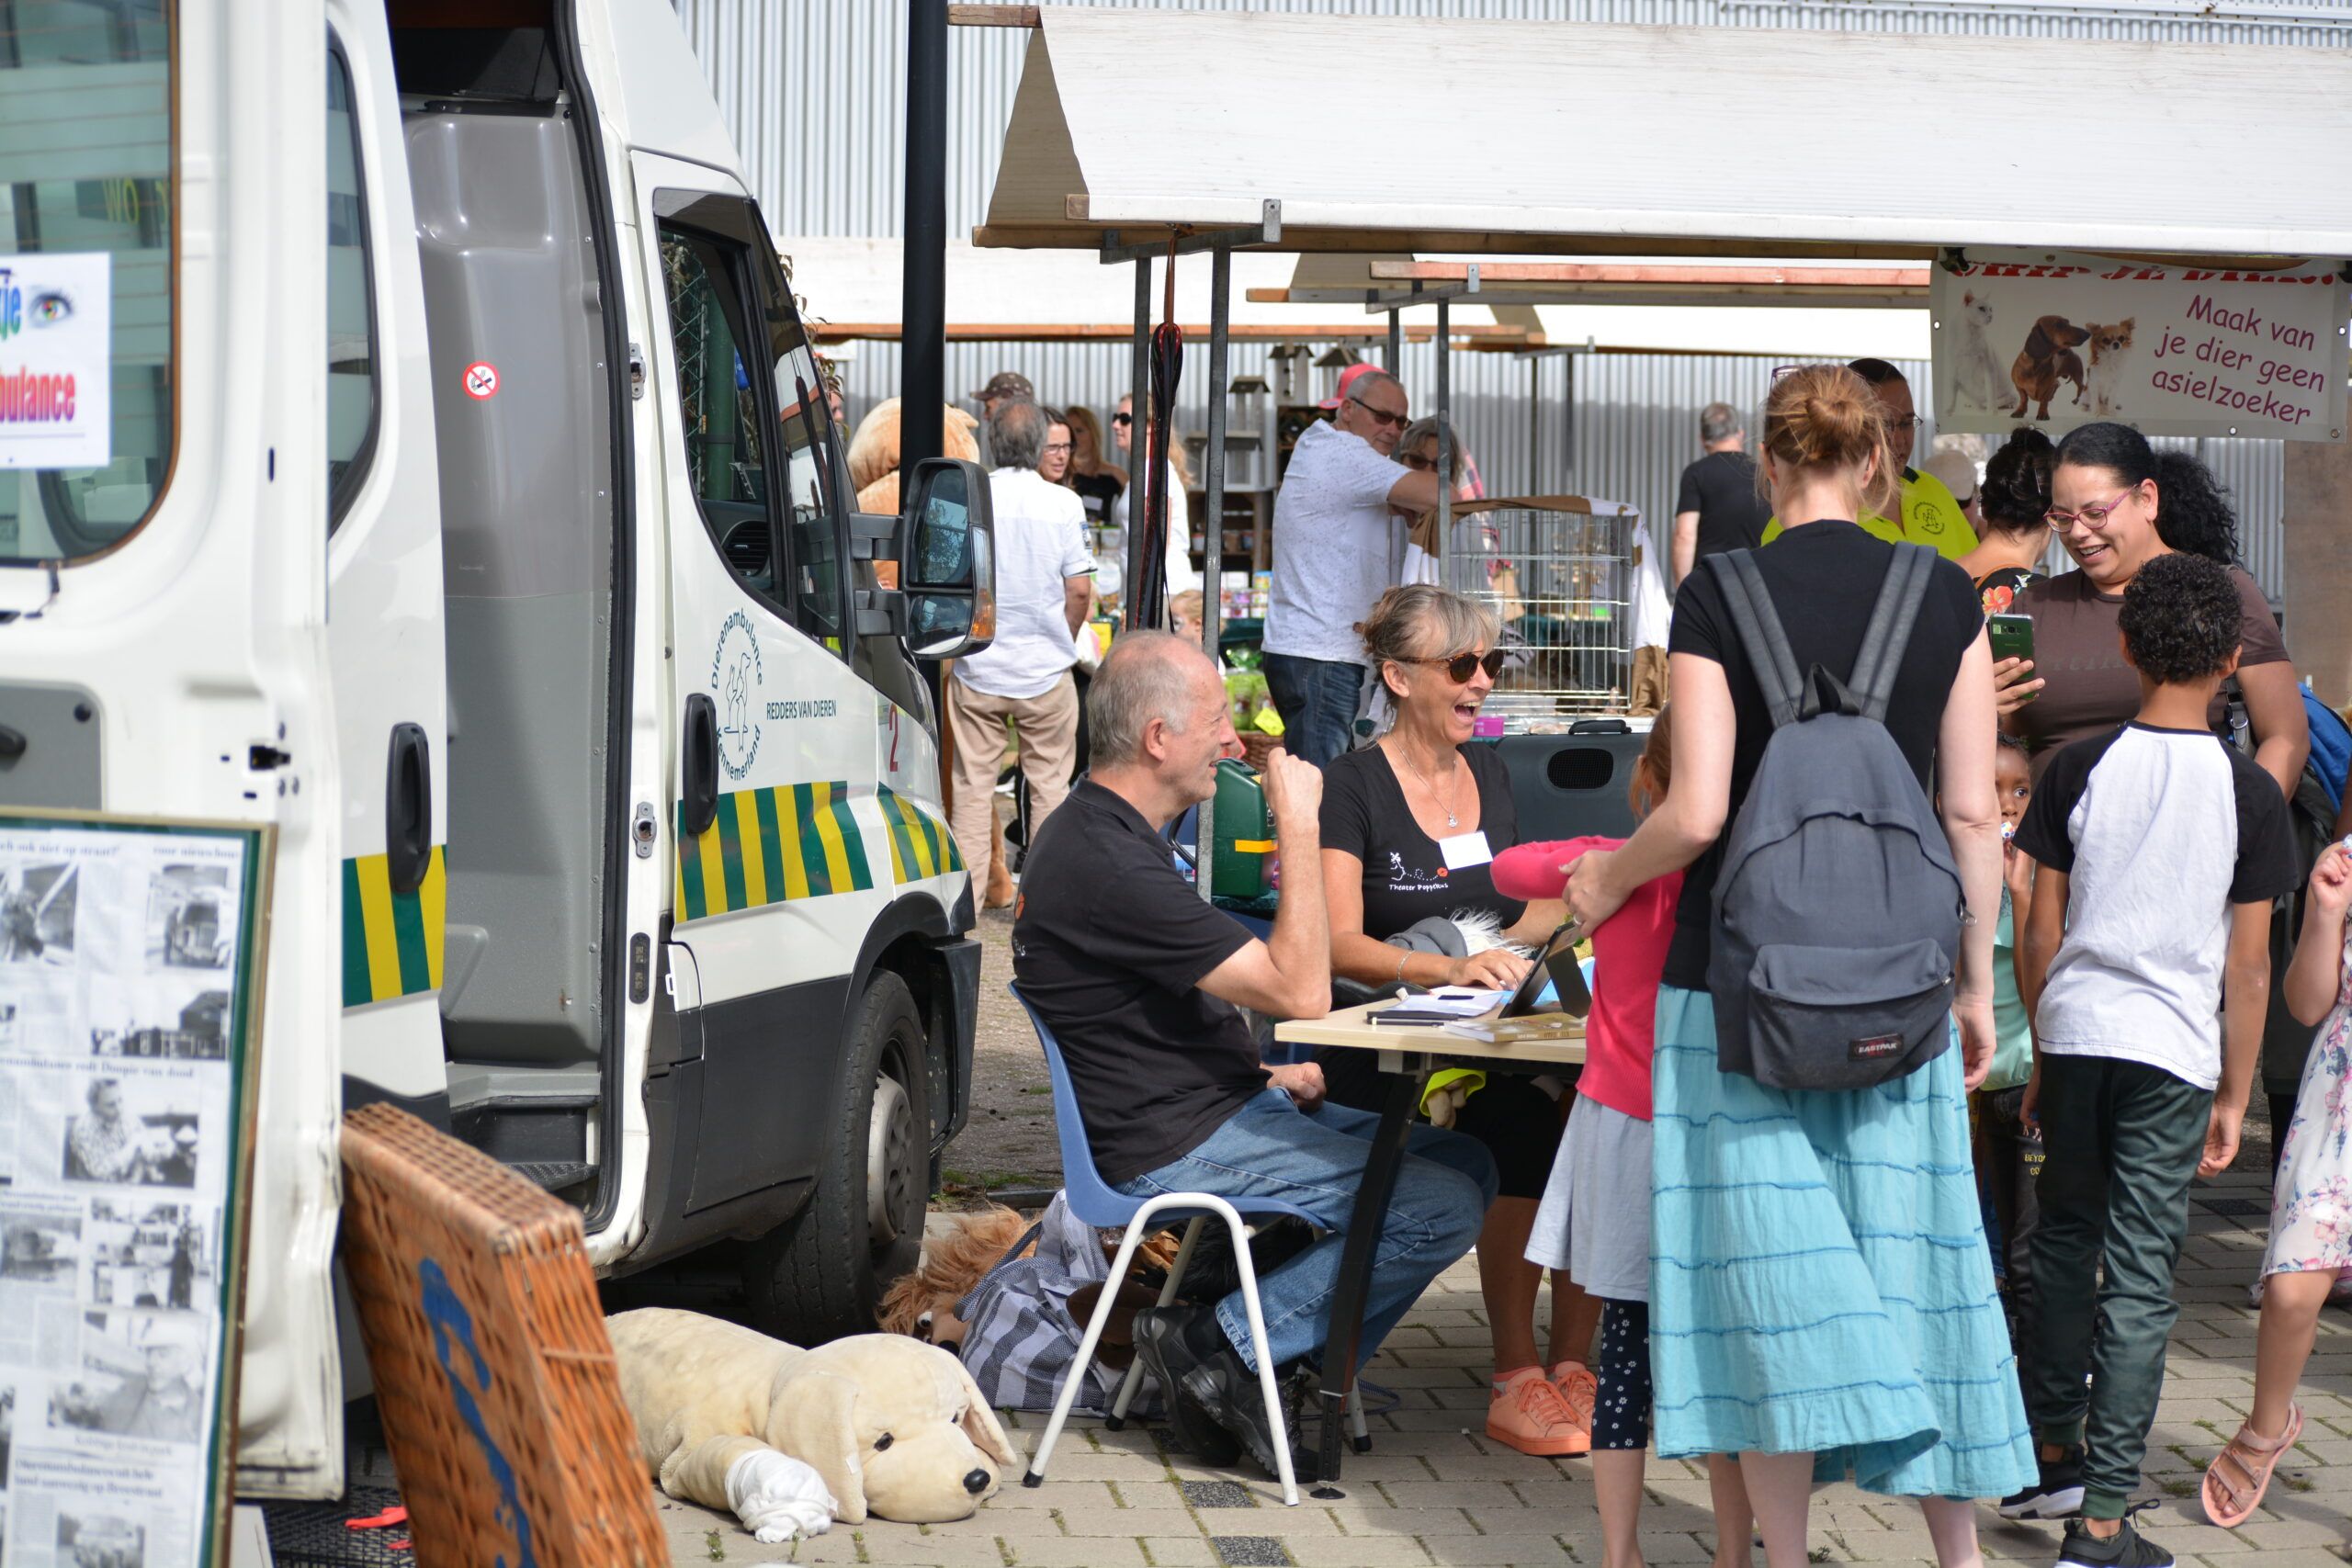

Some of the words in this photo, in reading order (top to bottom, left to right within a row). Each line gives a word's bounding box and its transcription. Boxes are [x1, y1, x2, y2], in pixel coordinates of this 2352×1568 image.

[2187, 294, 2262, 336] Maak
[2271, 321, 2315, 351] van
[2154, 325, 2187, 359] je
[2195, 336, 2254, 371] dier
[2256, 360, 2325, 393] geen
[2152, 369, 2312, 425] asielzoeker
[711, 607, 763, 690] Dierenambulance
[766, 701, 797, 720] REDDERS
[798, 700, 812, 718] VAN
[813, 699, 837, 718] DIEREN
[888, 704, 899, 773] 2
[1859, 1043, 1897, 1054] EASTPAK
